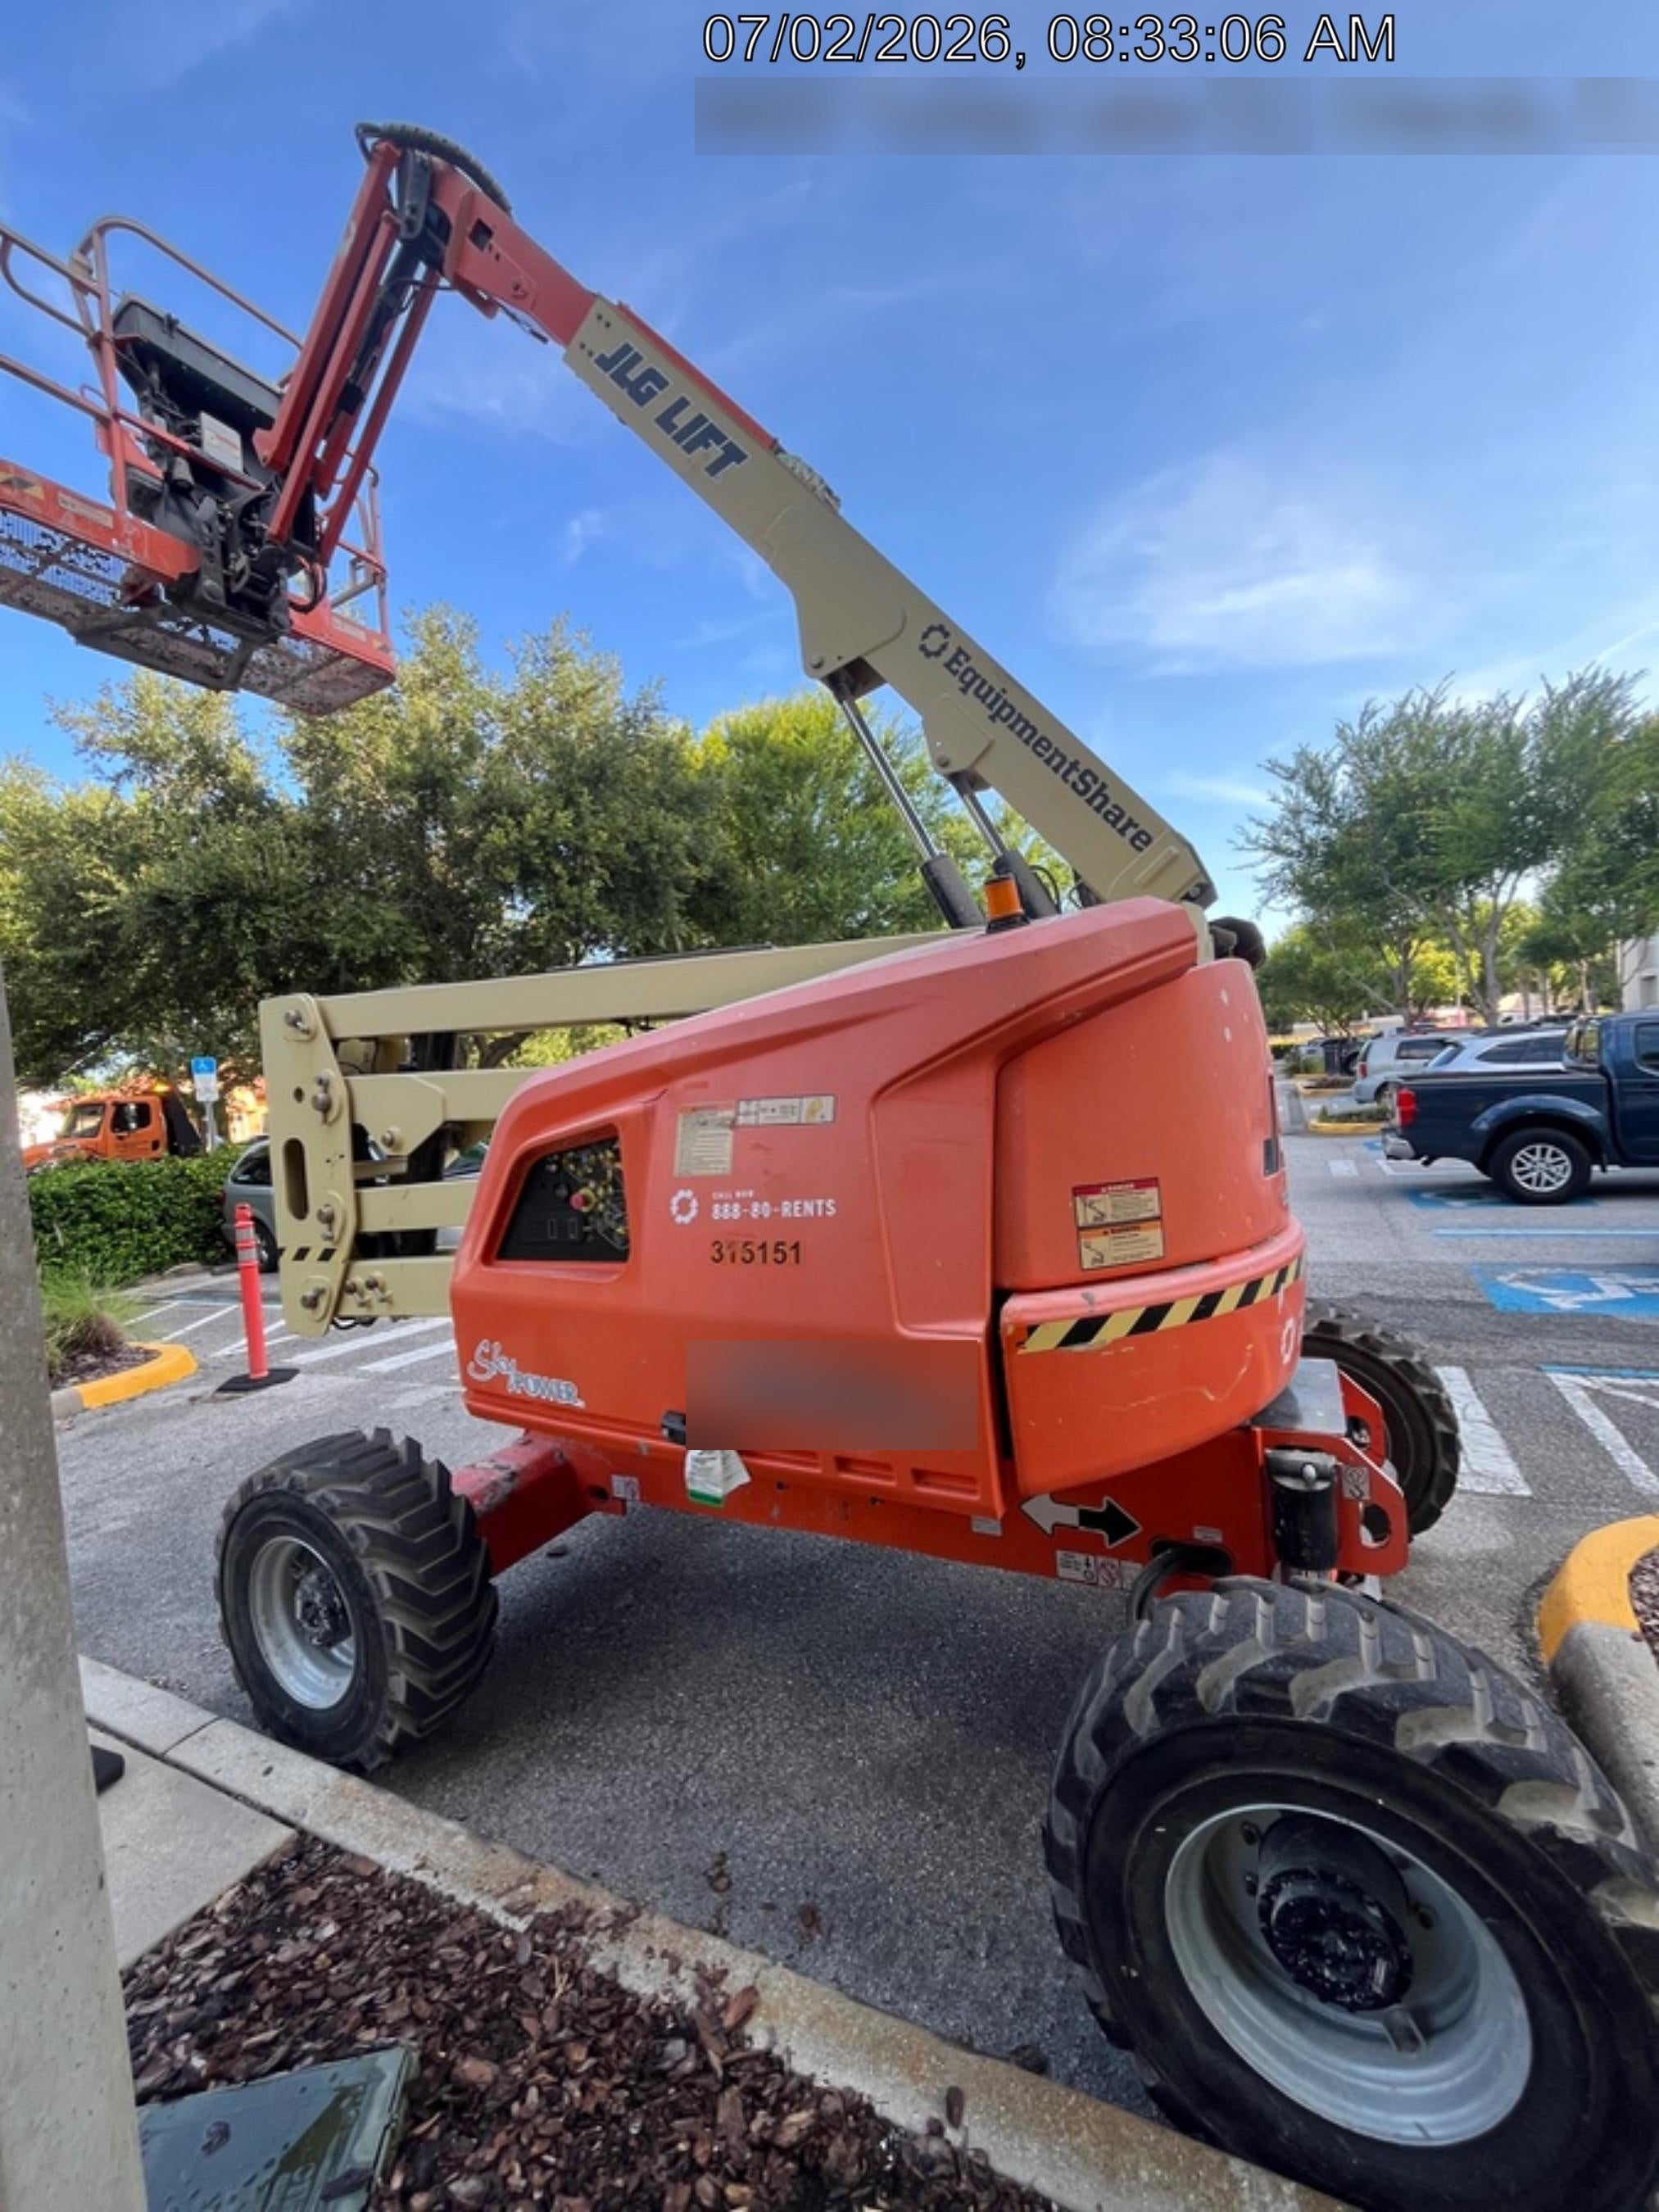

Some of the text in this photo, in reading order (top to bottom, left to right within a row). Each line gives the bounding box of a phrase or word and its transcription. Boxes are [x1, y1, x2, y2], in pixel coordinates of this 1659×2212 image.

[594, 342, 749, 478] JLG LIFT
[943, 646, 1154, 853] EquipmentShare
[712, 1199, 836, 1220] 888-80-RENTS
